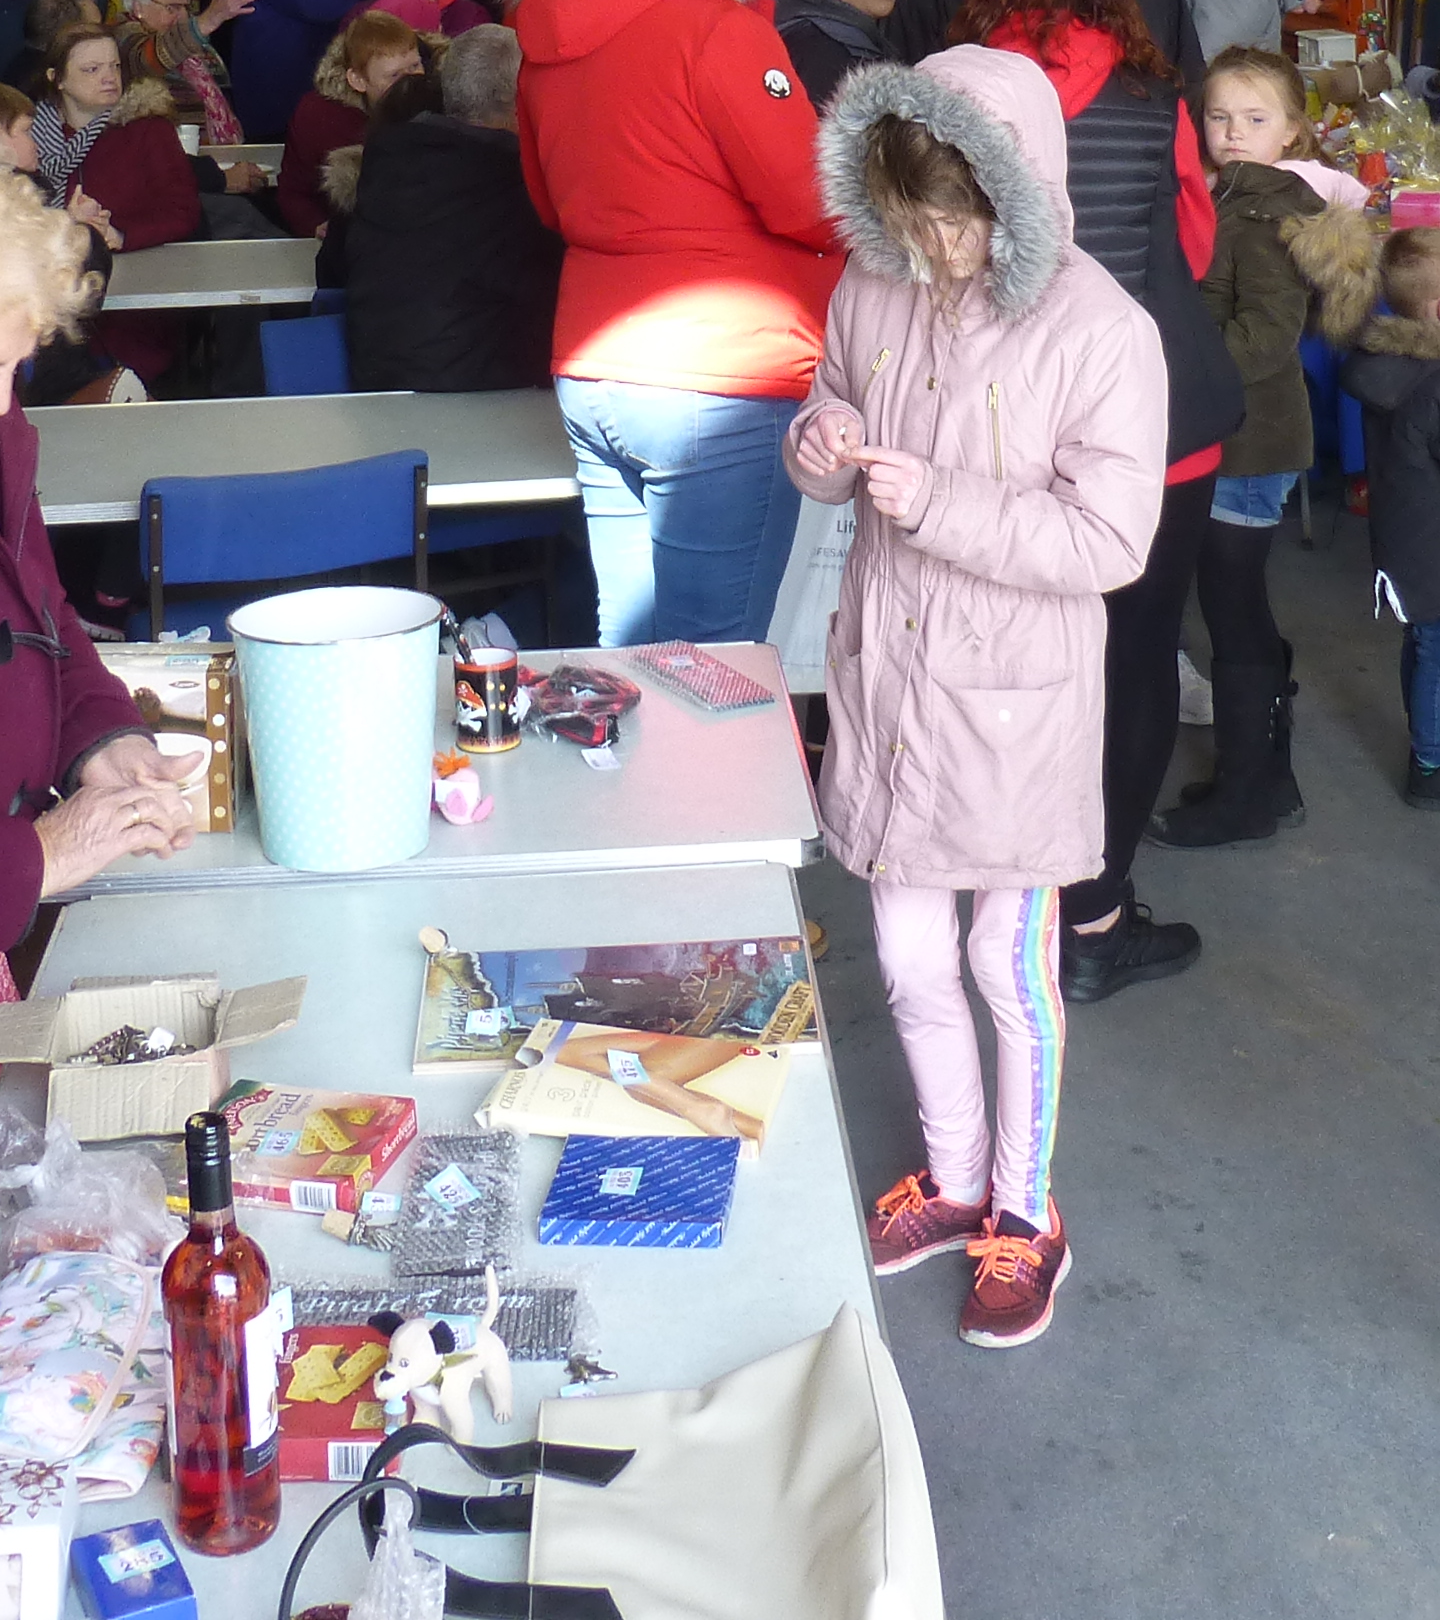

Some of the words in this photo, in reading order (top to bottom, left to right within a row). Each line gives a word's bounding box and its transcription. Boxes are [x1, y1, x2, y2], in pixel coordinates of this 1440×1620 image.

[761, 1010, 797, 1045] WOODEN
[500, 1071, 526, 1110] CHARNOS
[547, 1086, 576, 1102] 3
[271, 1130, 294, 1152] 465
[298, 1288, 443, 1314] Pirate's
